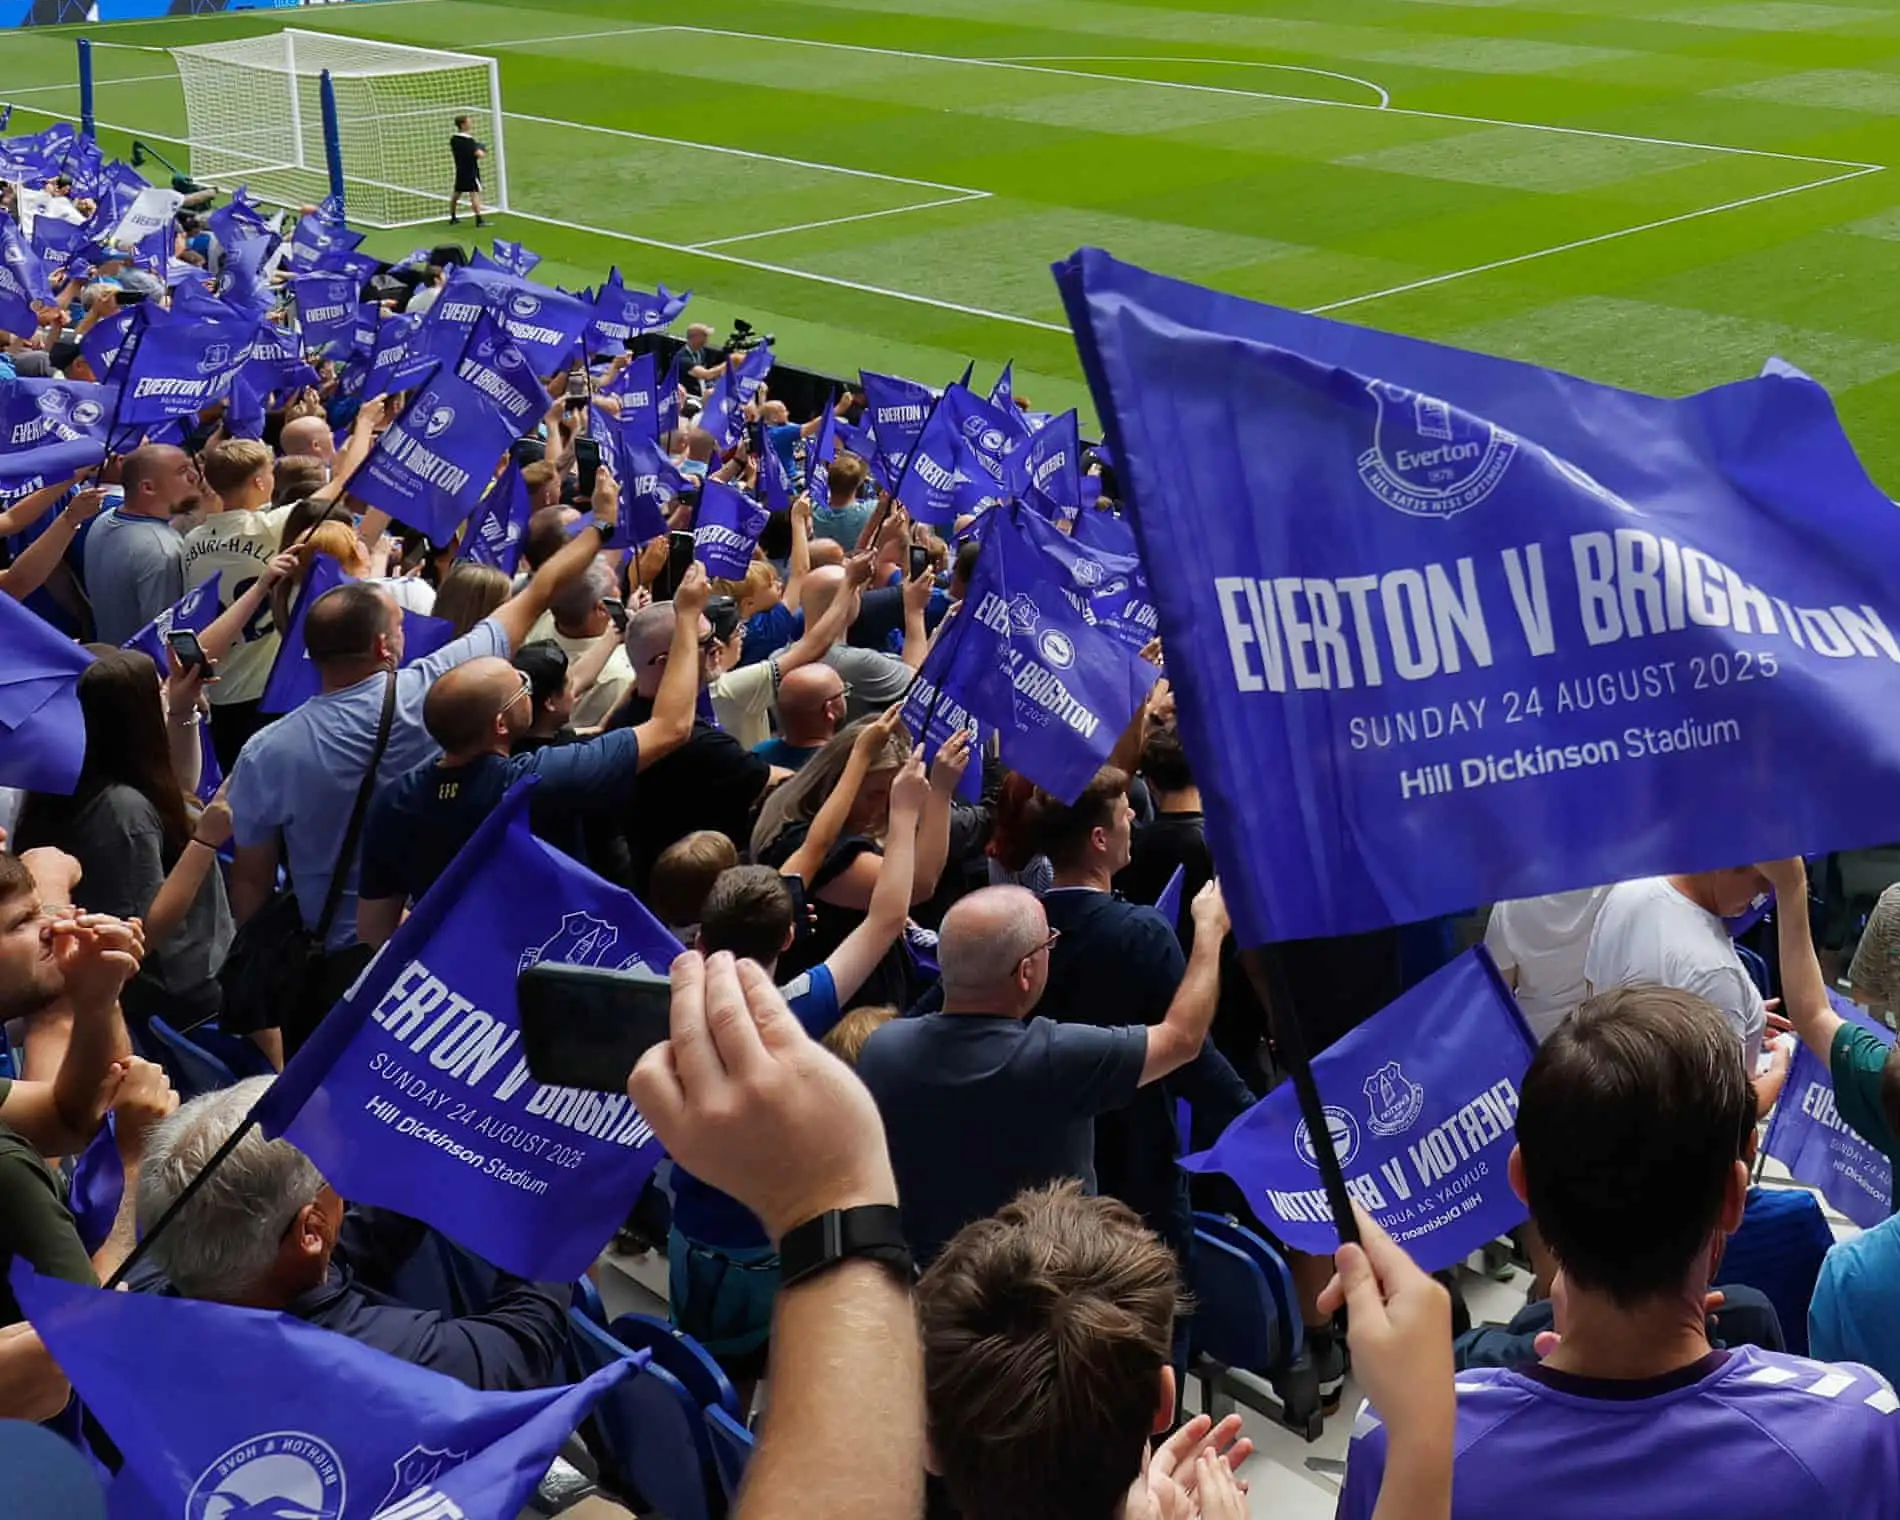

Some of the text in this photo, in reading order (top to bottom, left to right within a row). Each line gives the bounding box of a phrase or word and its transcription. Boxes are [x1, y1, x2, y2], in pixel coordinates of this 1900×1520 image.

[134, 377, 208, 398] EVERTON
[1369, 473, 1388, 495] NIL
[1391, 490, 1428, 511] SATIS
[1465, 450, 1508, 502] OPTIMUM
[1396, 442, 1479, 470] Everton
[1216, 558, 1494, 693] EVERTON
[1502, 542, 1557, 657] V
[1014, 661, 1100, 739] BRIGHTON
[1349, 651, 1779, 750] SUNDAY 24 AUGUST 2025
[1400, 718, 1741, 799] Hill Dickinson Stadium
[371, 959, 521, 1087] ERTON
[363, 1094, 549, 1197] Hill Dickinson Stadium
[368, 1052, 587, 1170] SUNDAY 24 AUGUST 2025
